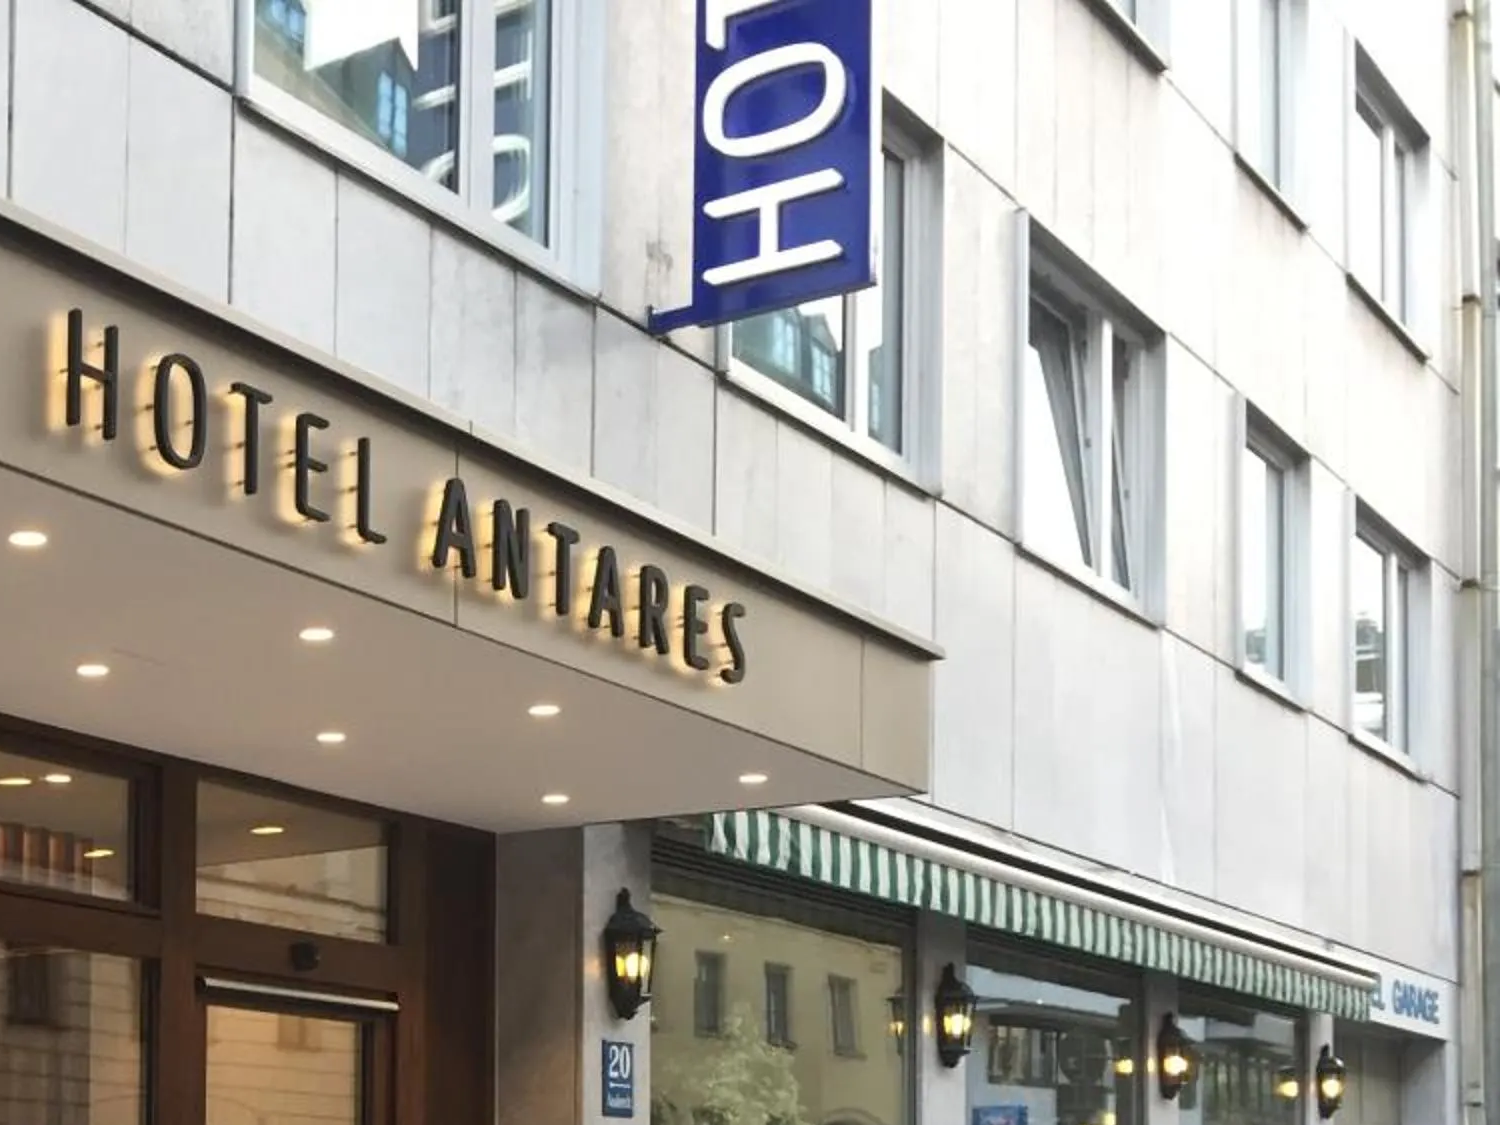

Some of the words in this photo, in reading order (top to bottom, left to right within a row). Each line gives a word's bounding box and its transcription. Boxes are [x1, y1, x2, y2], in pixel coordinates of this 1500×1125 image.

[65, 308, 388, 545] HOTEL
[431, 477, 747, 686] ANTARES
[1393, 979, 1440, 1025] GARAGE
[608, 1045, 632, 1079] 20
